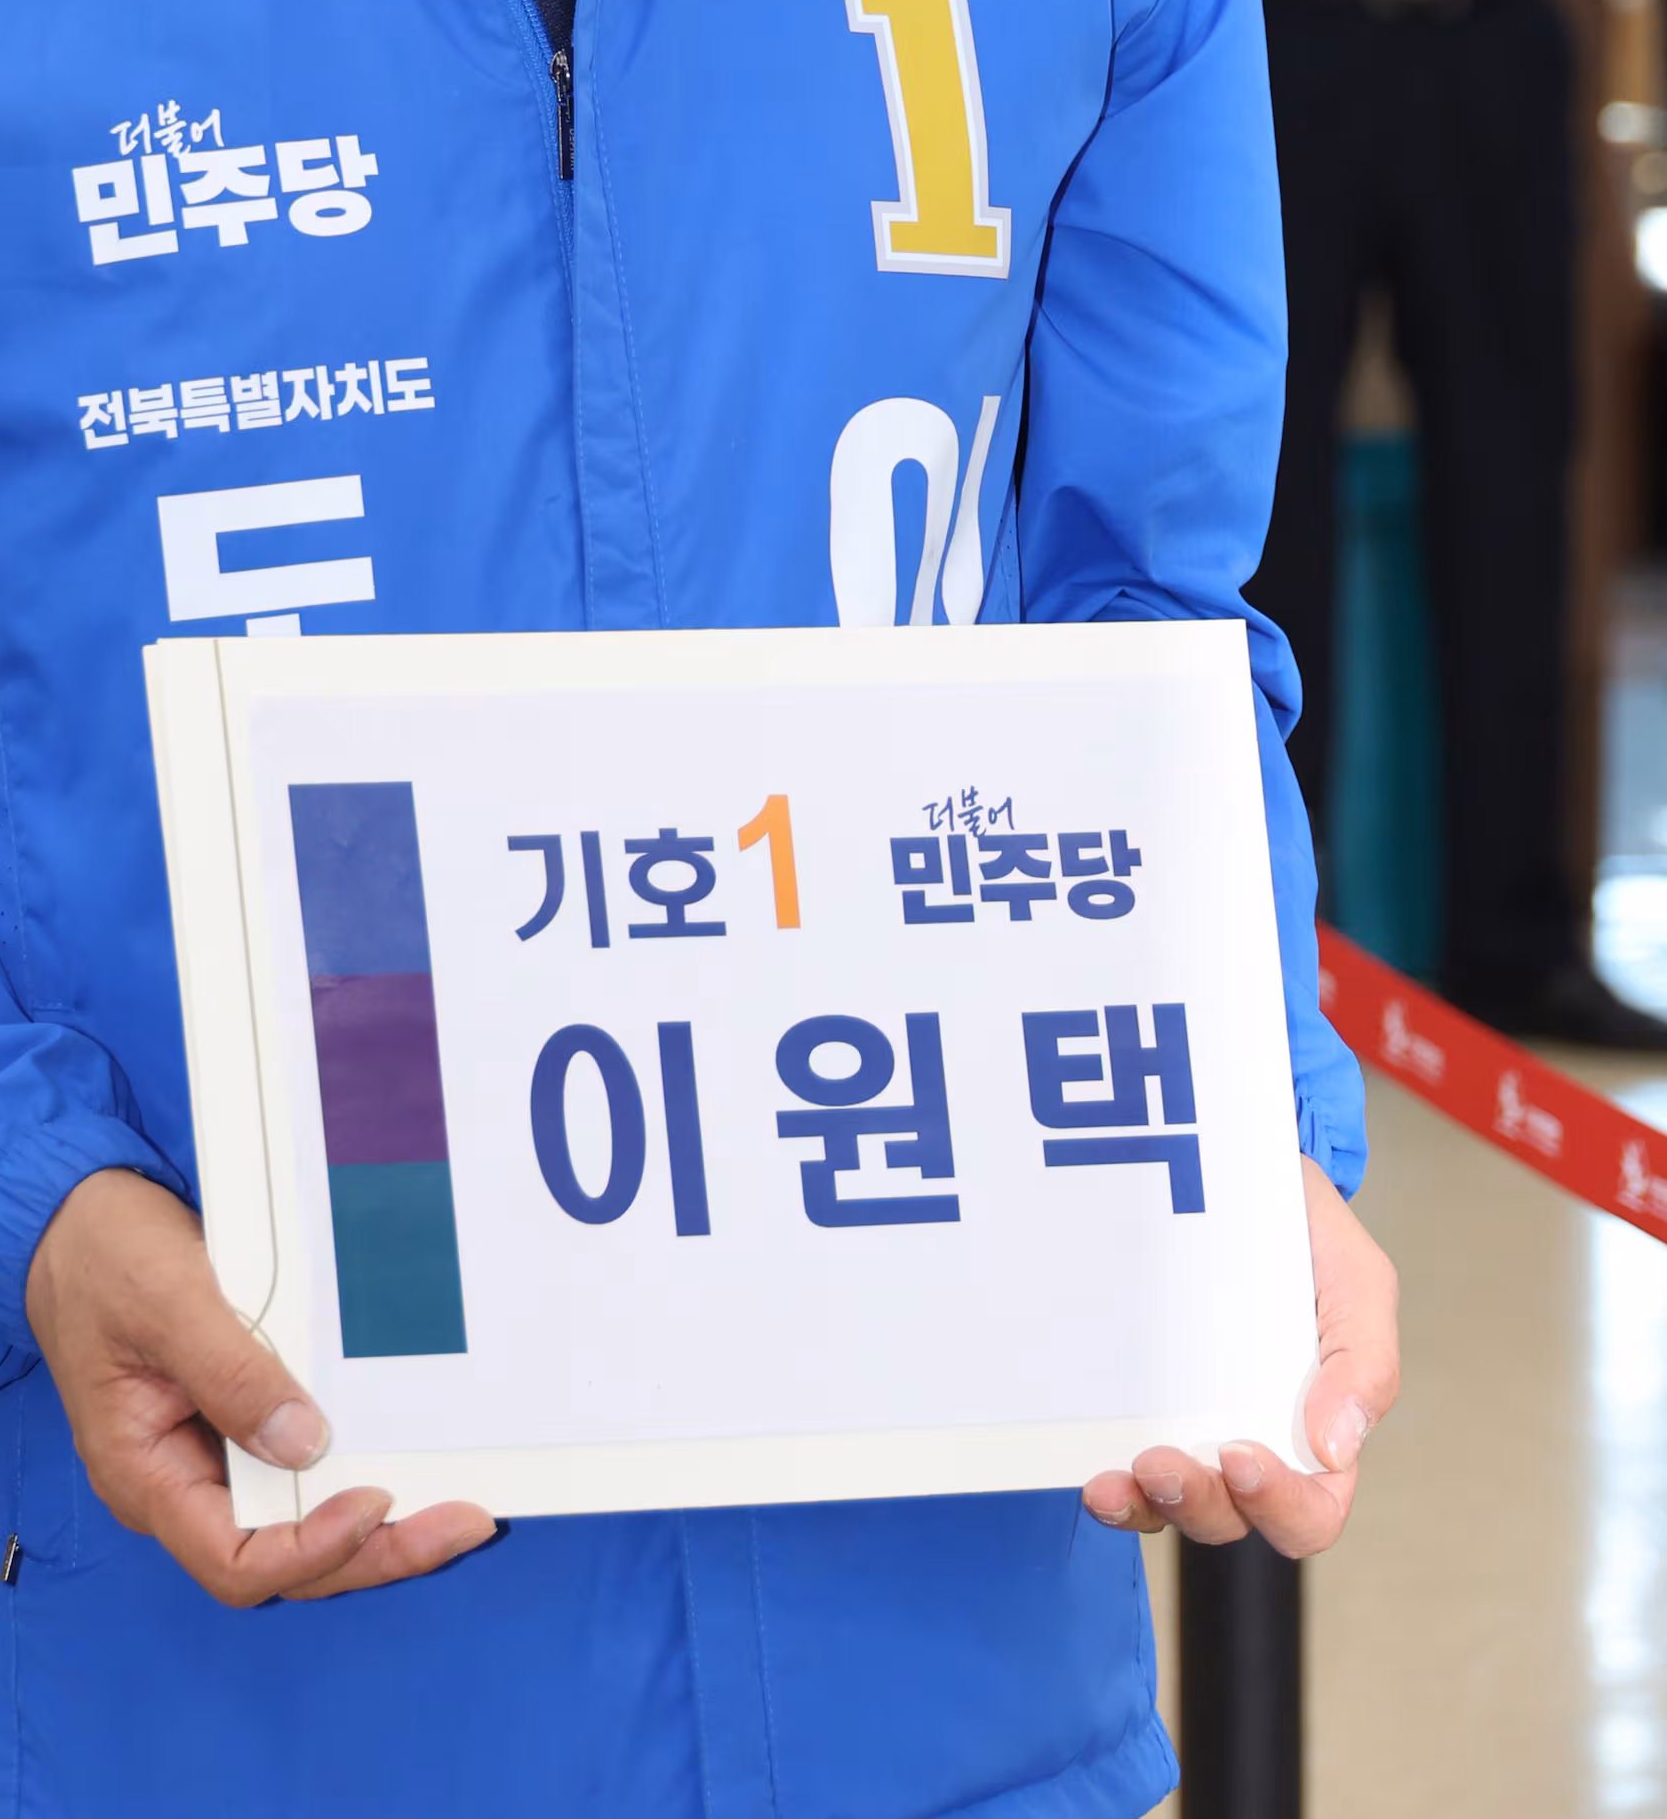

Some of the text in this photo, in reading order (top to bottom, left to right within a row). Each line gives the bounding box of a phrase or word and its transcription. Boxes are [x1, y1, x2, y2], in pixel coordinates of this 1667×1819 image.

[109, 99, 225, 161] 더불어
[72, 134, 379, 266] 민주당
[77, 357, 435, 450] 전북특별자치도
[921, 785, 1015, 838] 더불어
[889, 829, 1141, 925] 민주당
